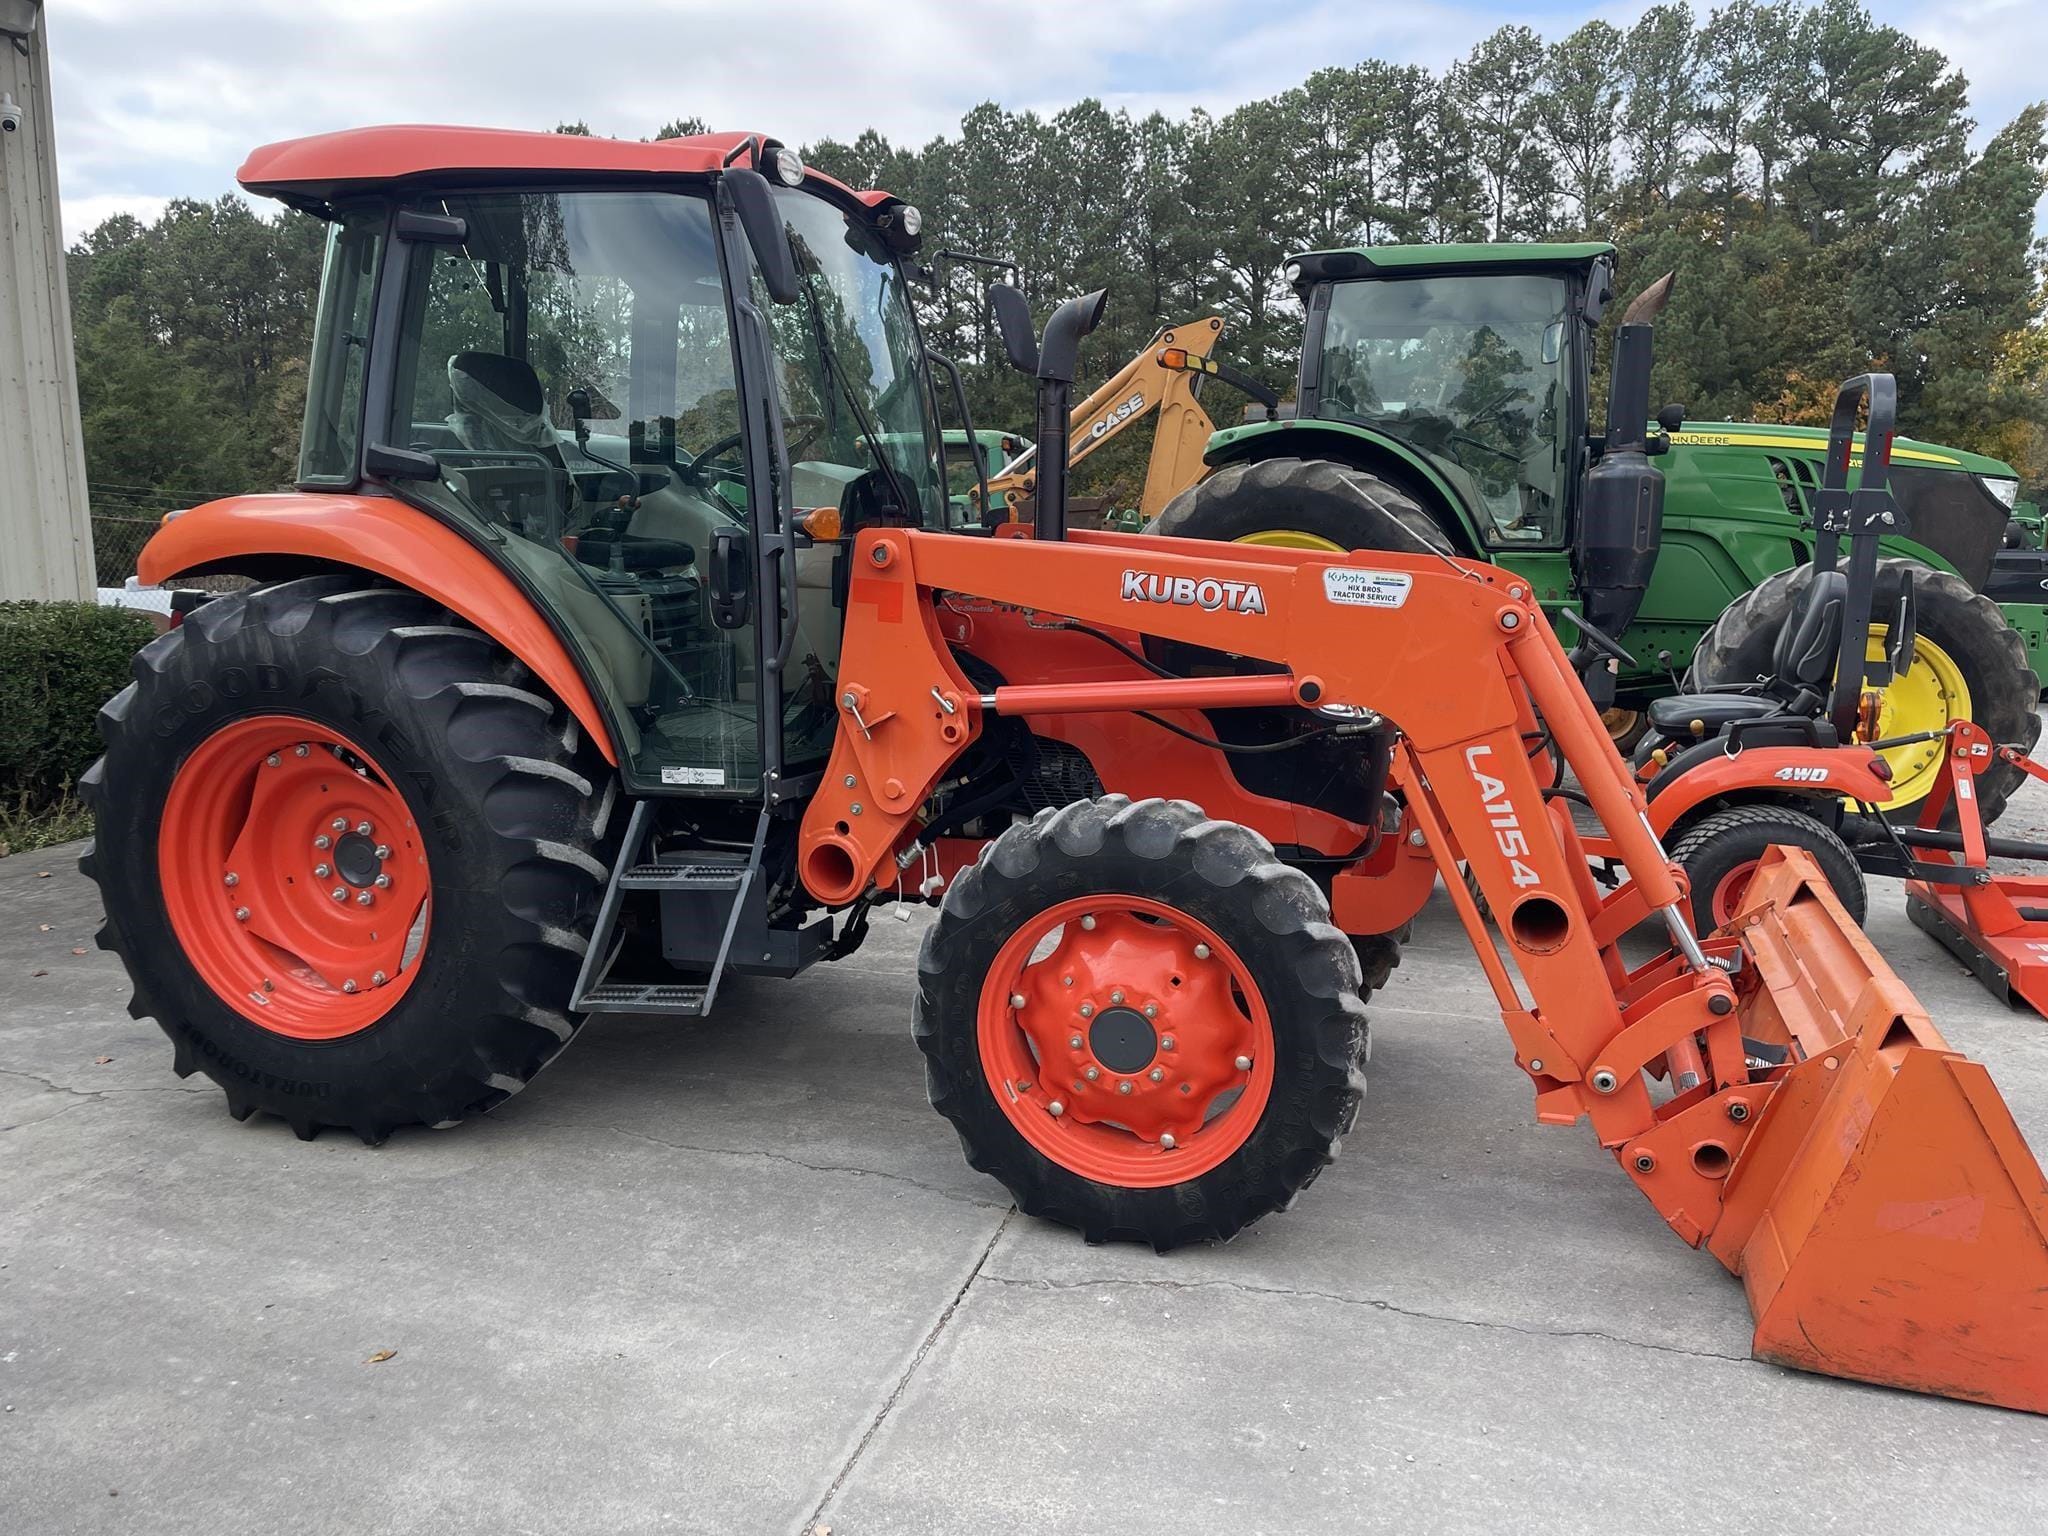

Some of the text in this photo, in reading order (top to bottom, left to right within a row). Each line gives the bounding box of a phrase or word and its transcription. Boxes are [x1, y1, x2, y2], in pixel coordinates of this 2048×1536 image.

[1091, 392, 1144, 438] CASE
[1690, 434, 1730, 444] DEERE
[1328, 571, 1365, 583] Kubota
[1122, 571, 1267, 616] KUBOTA
[1348, 584, 1383, 594] HIX BROS.
[1333, 590, 1365, 599] TRACTOR
[1366, 593, 1397, 602] SERVICE
[1774, 767, 1829, 782] 4WD
[1465, 745, 1542, 888] LA1154
